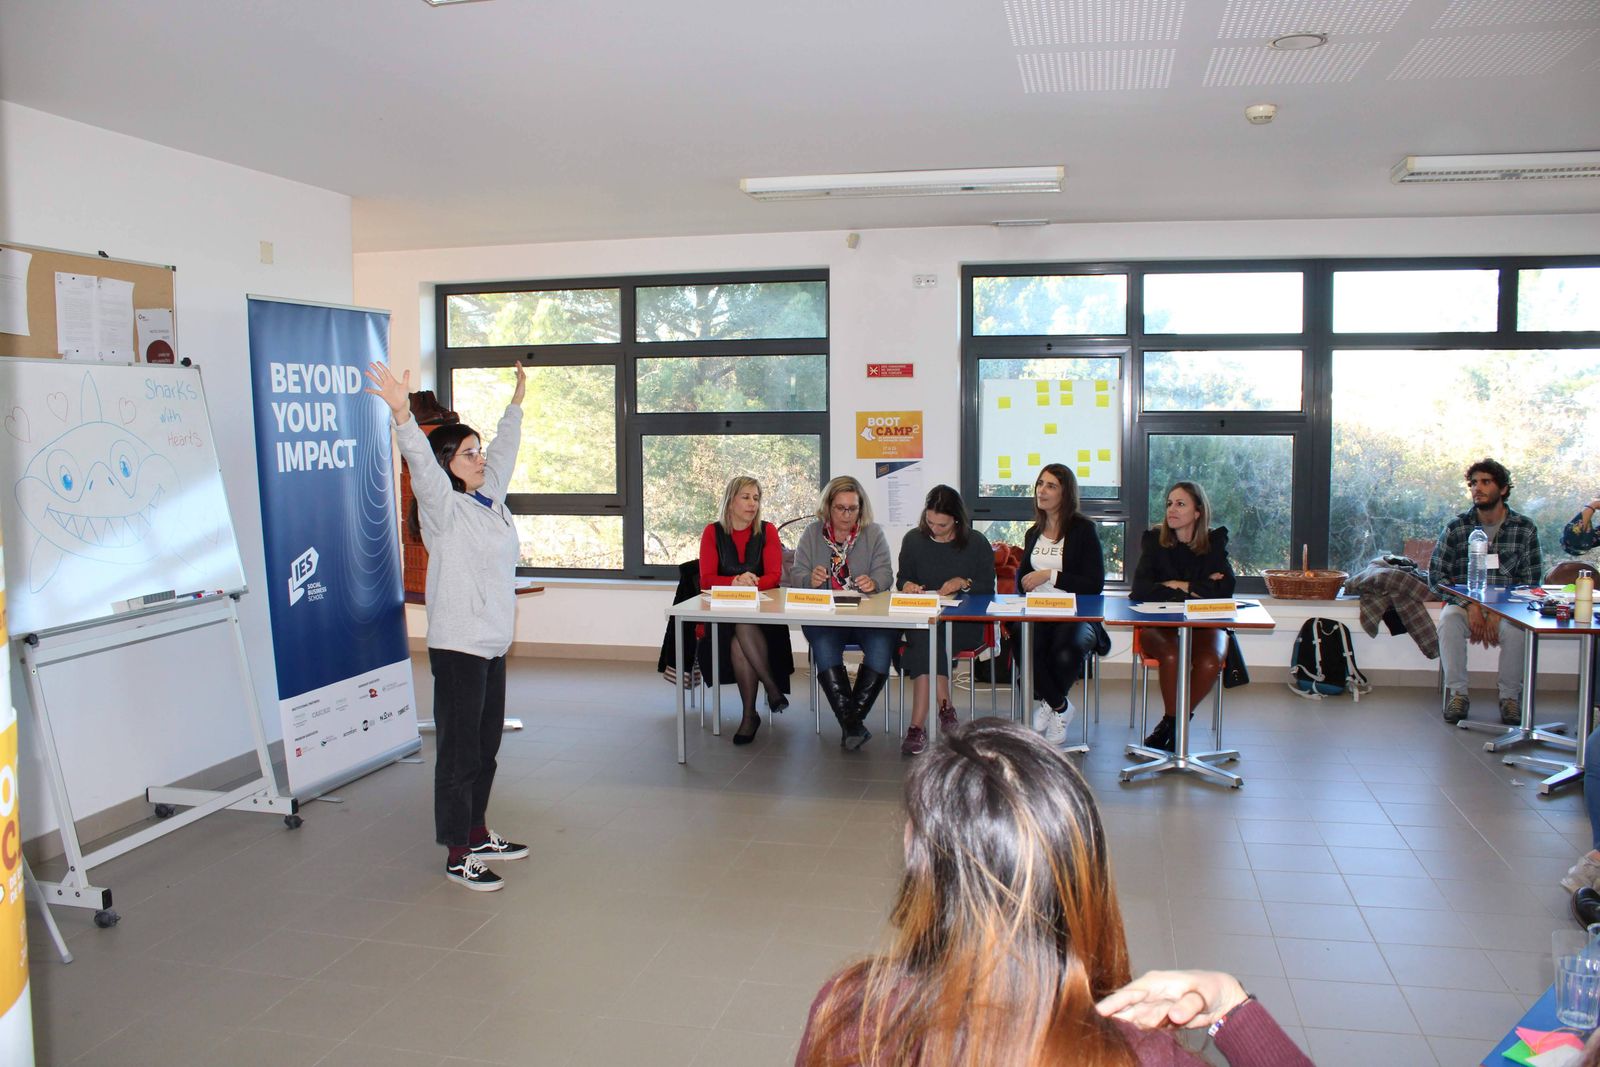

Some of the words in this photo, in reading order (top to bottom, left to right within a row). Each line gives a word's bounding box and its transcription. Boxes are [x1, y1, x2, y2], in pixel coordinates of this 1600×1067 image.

[270, 362, 362, 394] BEYOND
[271, 402, 338, 433] YOUR
[867, 417, 900, 427] BOOT
[876, 426, 913, 436] CAMP
[168, 432, 202, 447] Hearts
[276, 439, 357, 473] IMPACT
[307, 582, 321, 590] SOCIAL
[308, 593, 324, 602] SCHOOL
